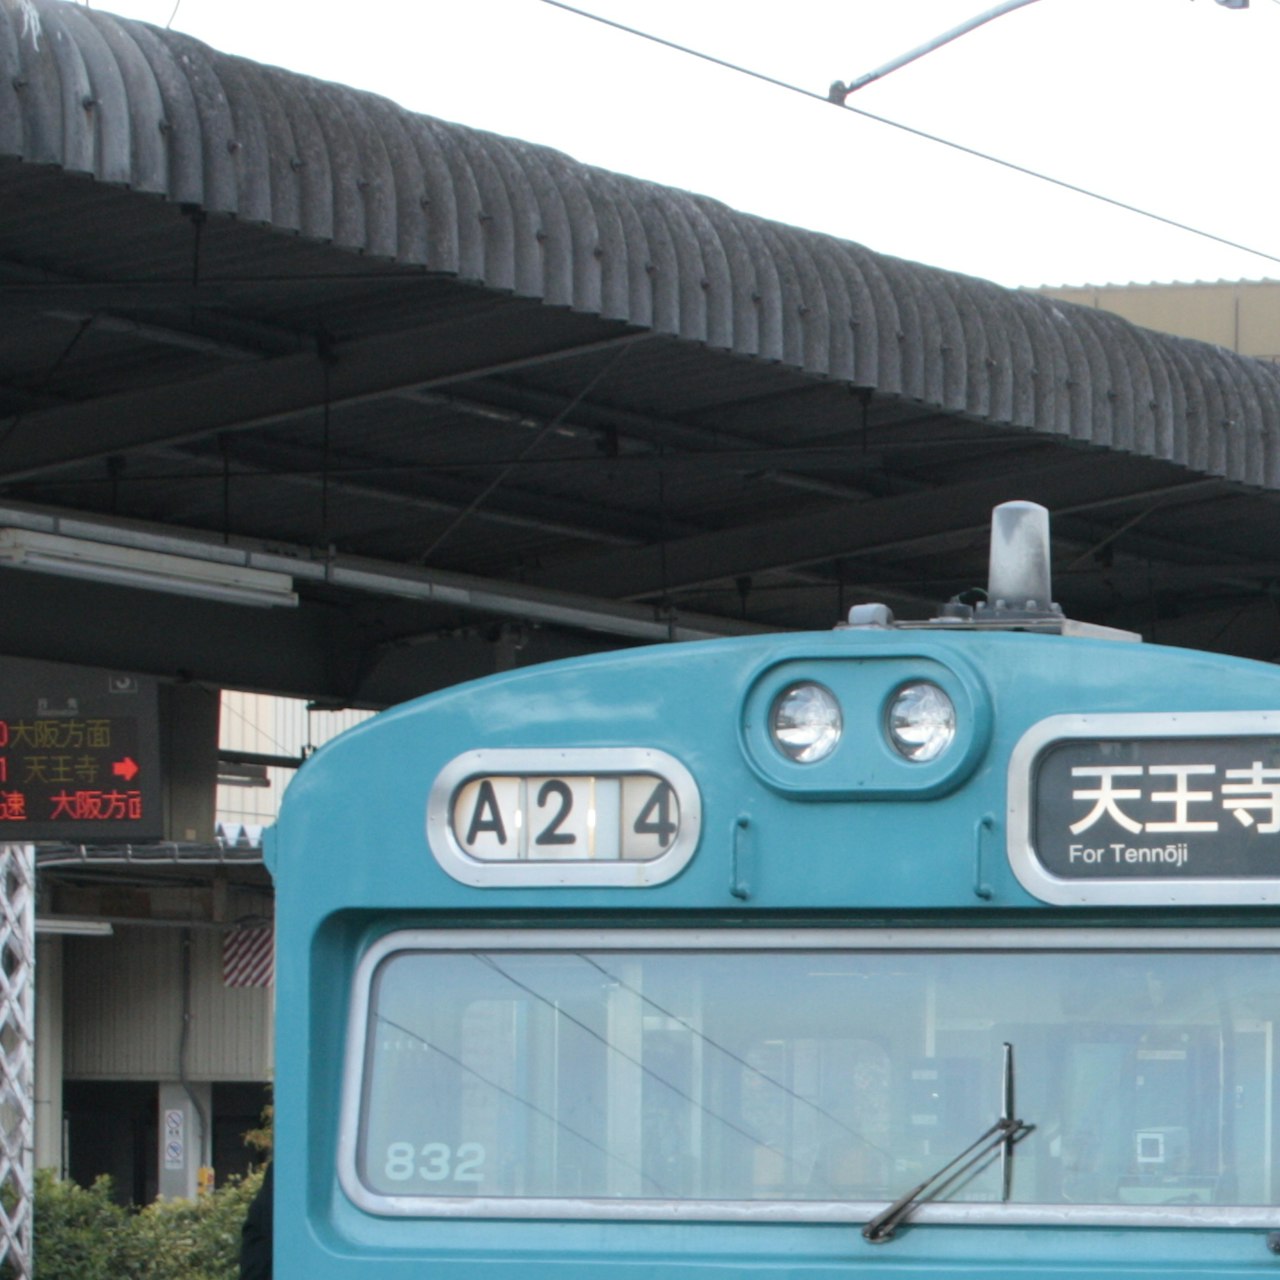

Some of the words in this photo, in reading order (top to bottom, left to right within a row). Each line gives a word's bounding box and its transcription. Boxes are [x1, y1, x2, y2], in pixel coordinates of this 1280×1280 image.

[9, 719, 111, 748] 大阪方面
[23, 755, 99, 783] 天王寺
[1069, 844, 1104, 863] For
[384, 1141, 485, 1182] 832
